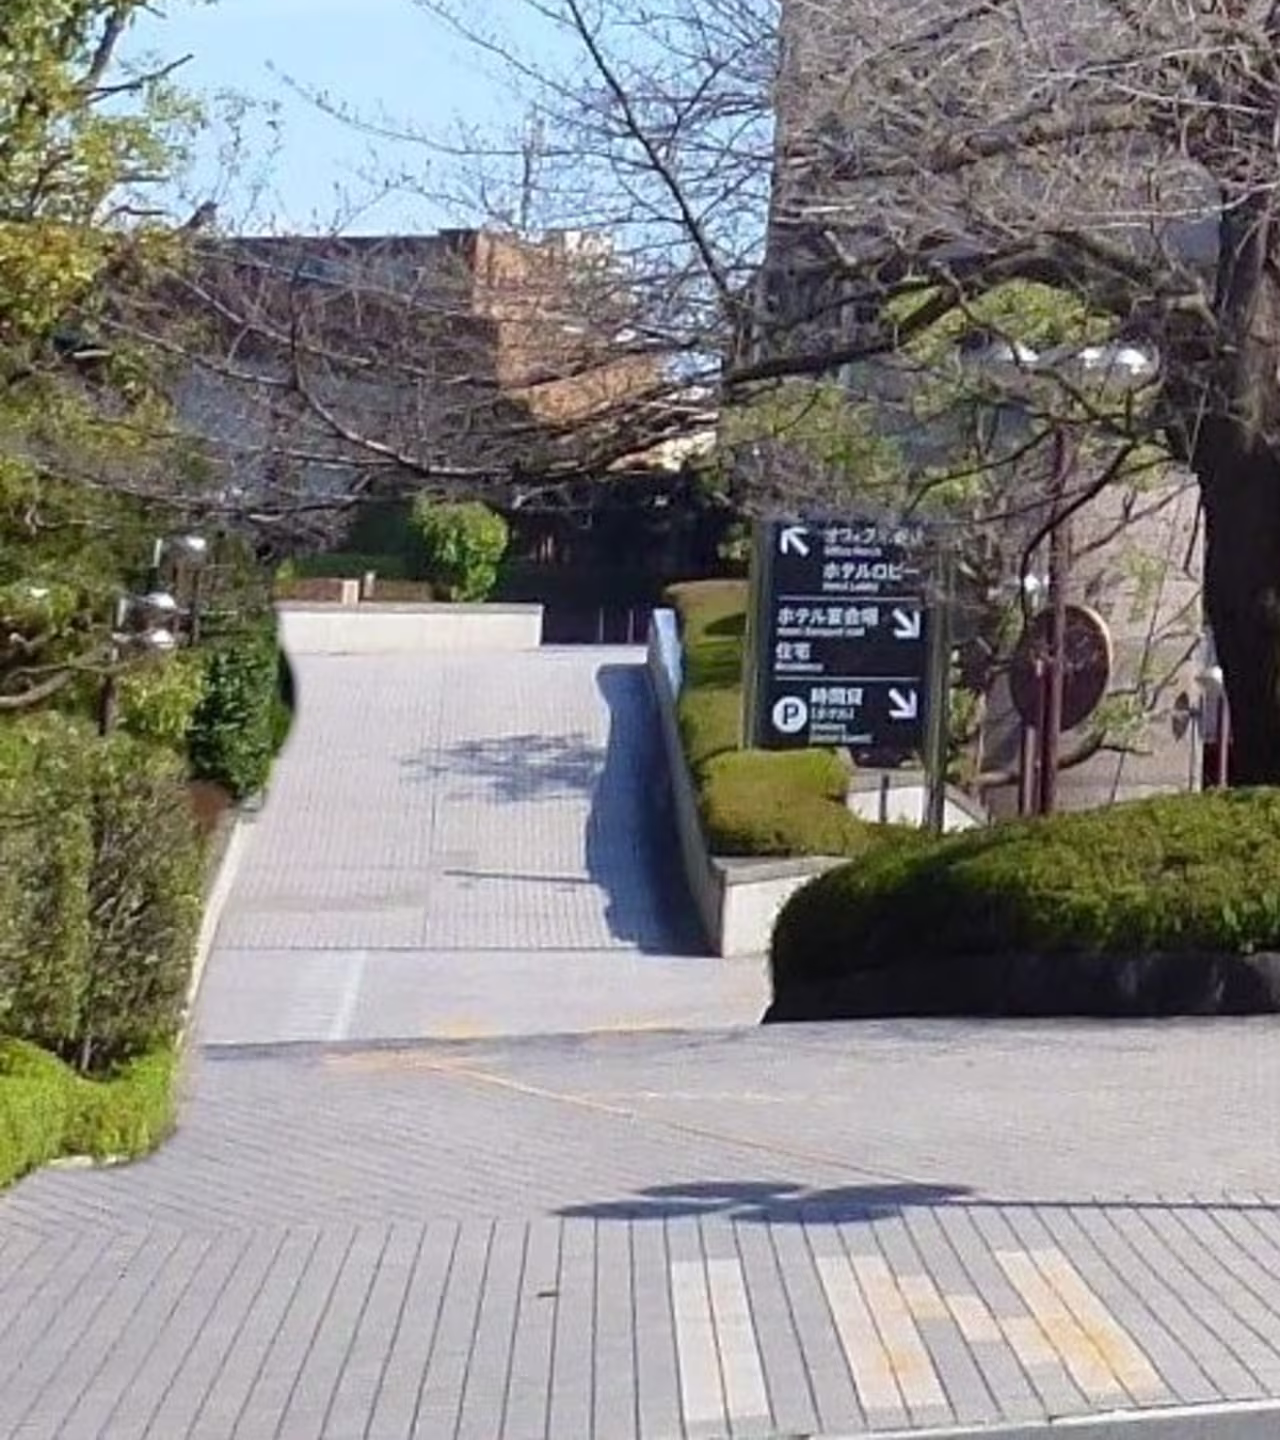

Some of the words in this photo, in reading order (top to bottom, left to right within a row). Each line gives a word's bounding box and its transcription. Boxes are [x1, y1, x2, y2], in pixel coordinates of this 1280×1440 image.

[823, 561, 920, 580] ホテルロビー
[775, 642, 811, 660] 住宅
